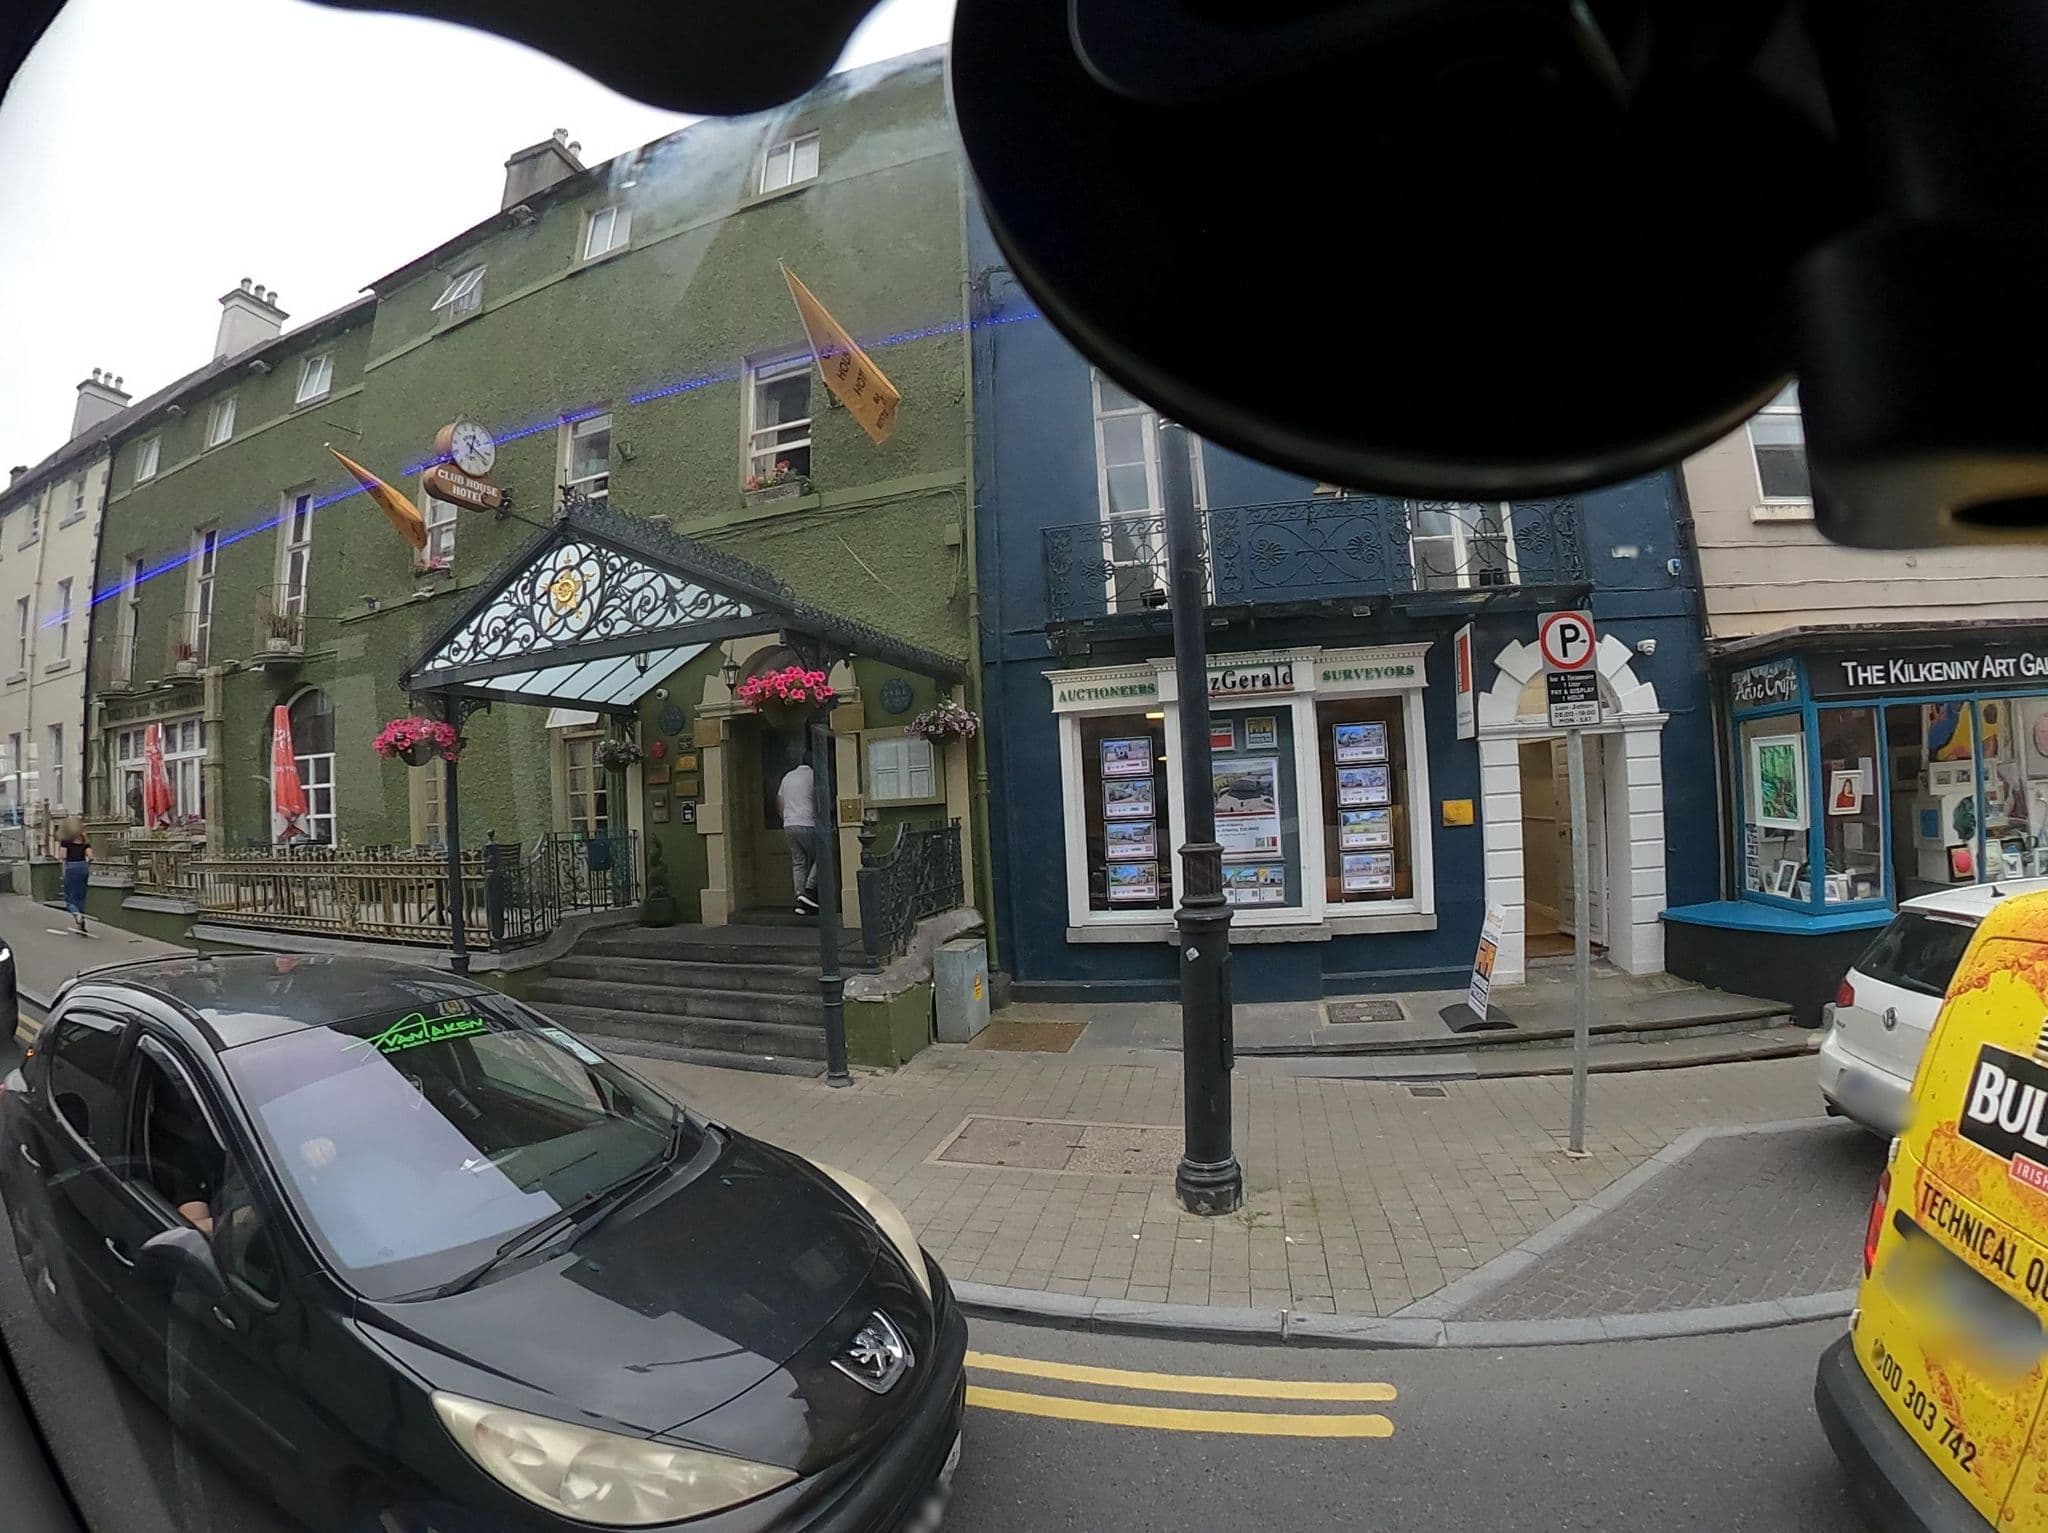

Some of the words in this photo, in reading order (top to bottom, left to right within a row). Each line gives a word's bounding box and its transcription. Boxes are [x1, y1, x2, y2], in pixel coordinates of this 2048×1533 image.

[466, 479, 499, 497] HOUSE
[1559, 623, 1581, 658] P
[1210, 663, 1295, 691] zGerald
[1322, 664, 1416, 682] SURVEYORS
[1841, 661, 1886, 687] THE
[1889, 659, 1980, 683] KILKENNY
[1982, 655, 2017, 679] ART
[1059, 682, 1157, 703] AUCTIONEERS
[1920, 1181, 2017, 1280] TECHNICAL
[1902, 1379, 1938, 1432] 303
[1938, 1417, 1977, 1473] 742
